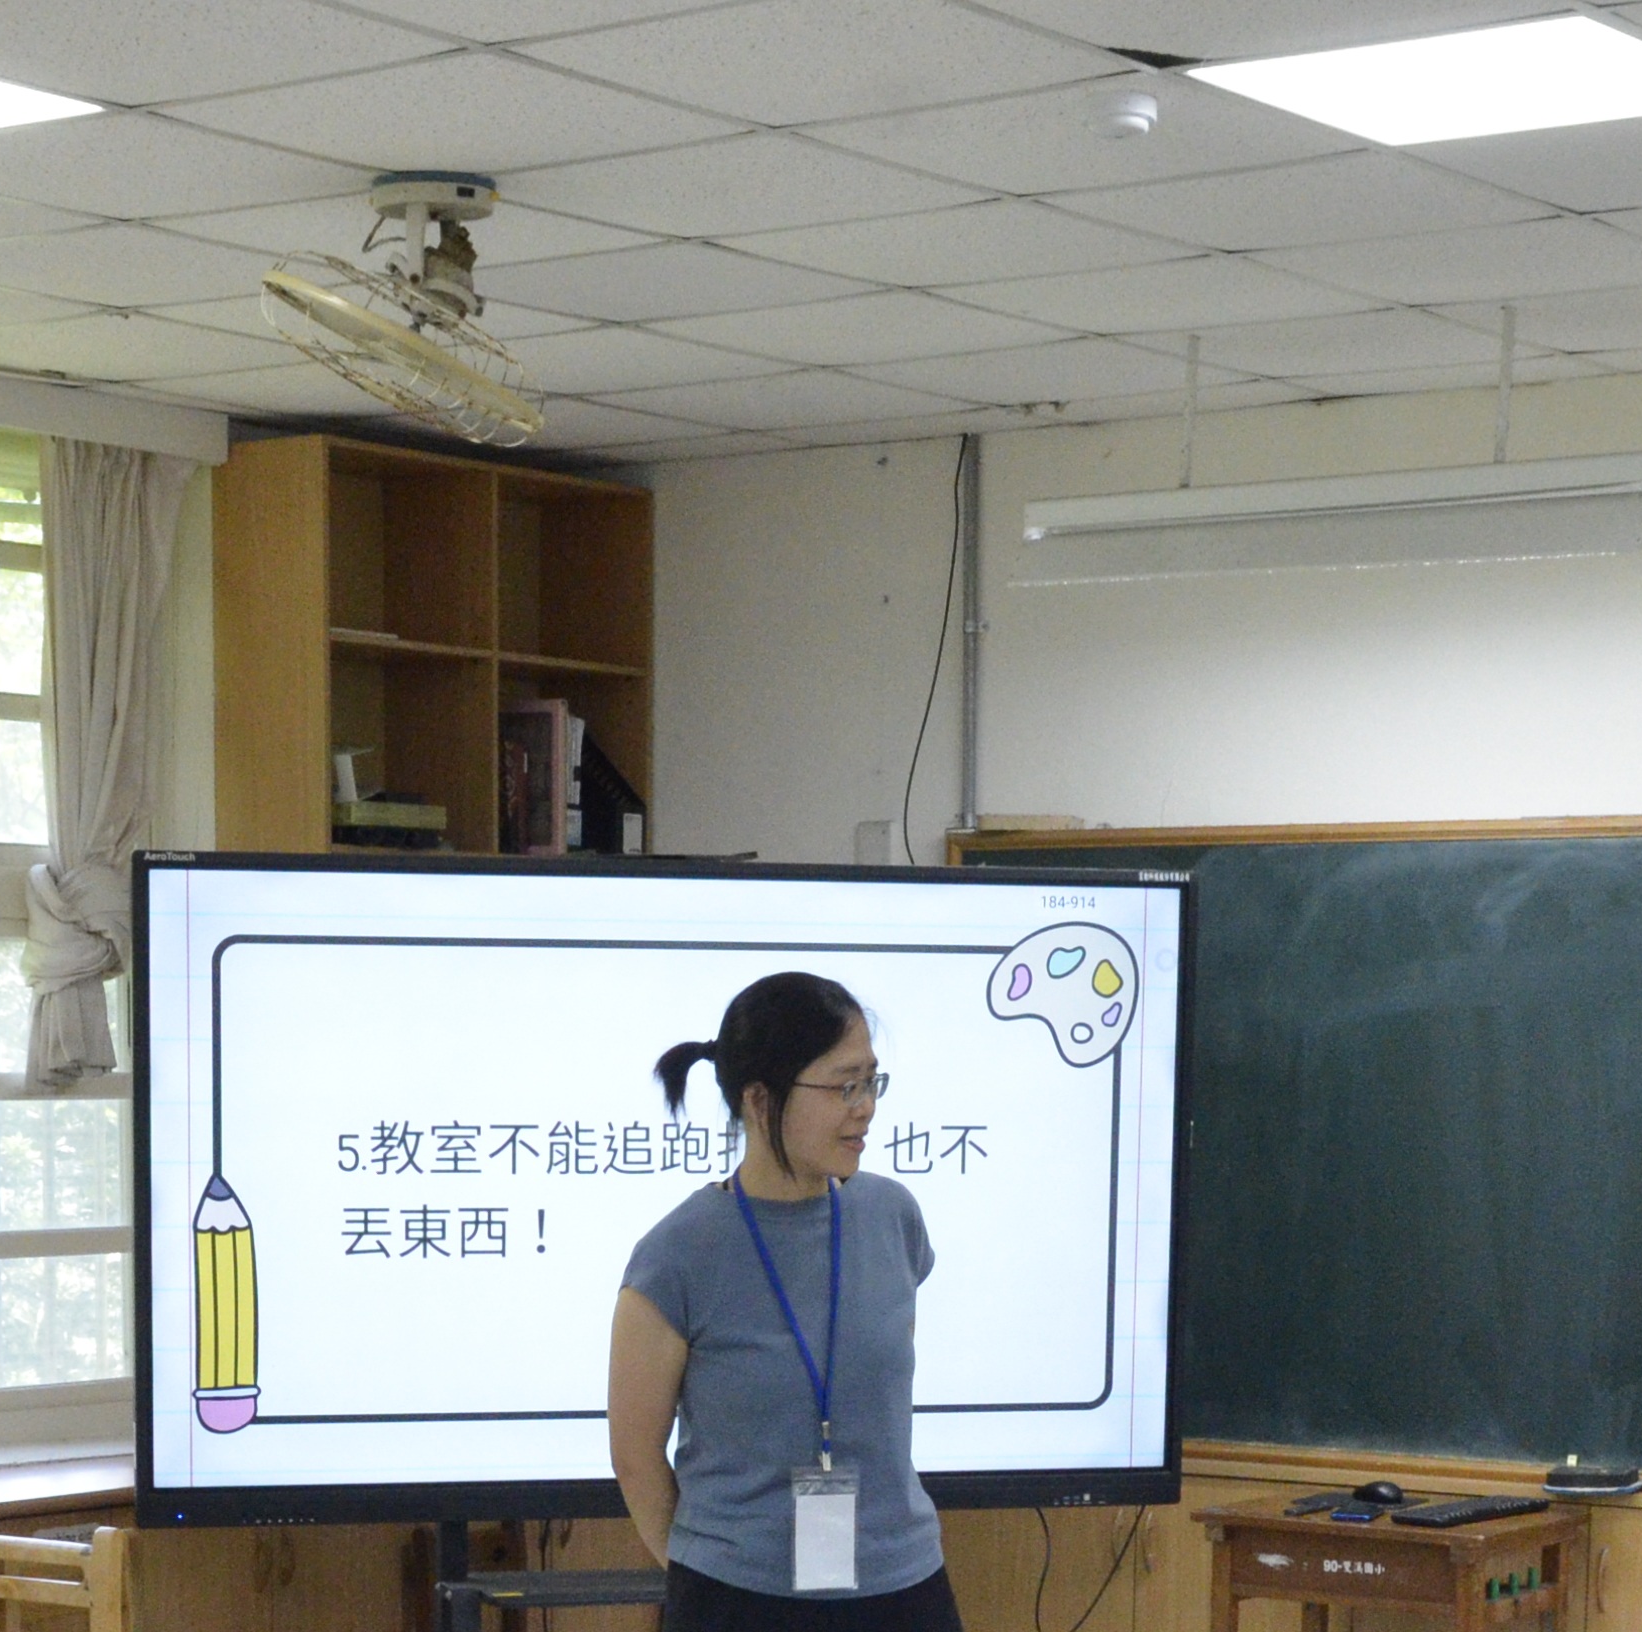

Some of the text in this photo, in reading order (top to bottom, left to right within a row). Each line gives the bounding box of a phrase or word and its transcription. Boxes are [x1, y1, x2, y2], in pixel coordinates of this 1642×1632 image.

[144, 851, 196, 861] AeroTouch
[1041, 895, 1096, 909] 184-914
[883, 1120, 989, 1175] 也不
[341, 1204, 546, 1259] 丟東西！
